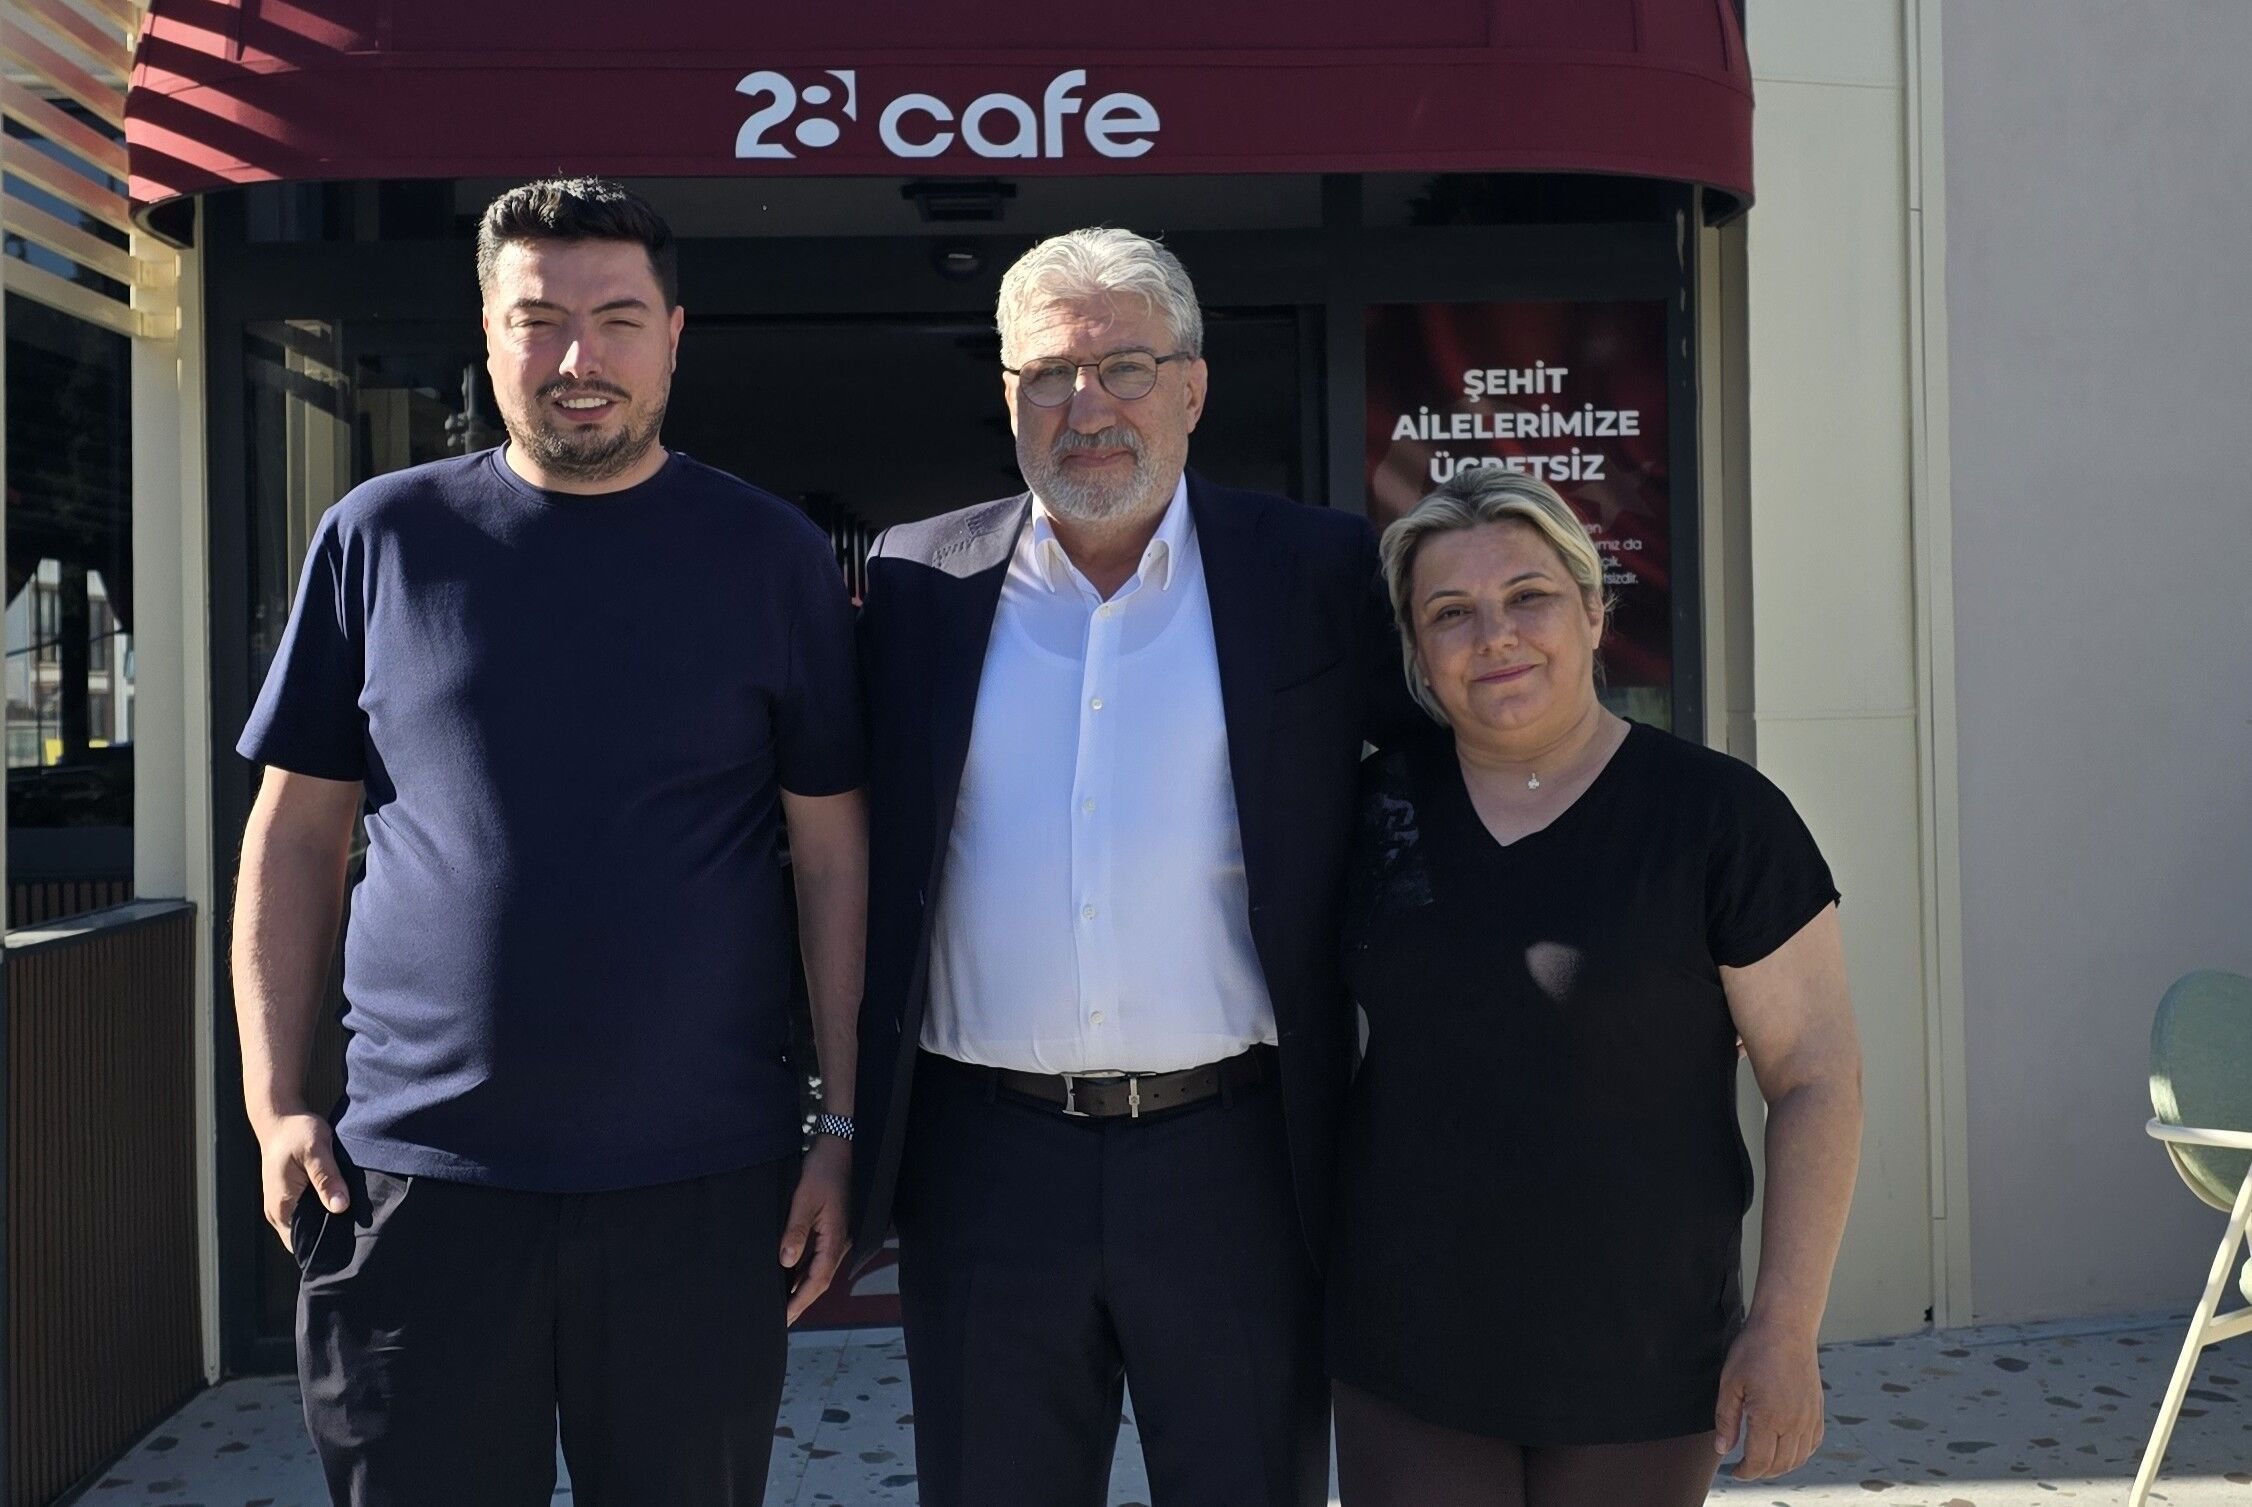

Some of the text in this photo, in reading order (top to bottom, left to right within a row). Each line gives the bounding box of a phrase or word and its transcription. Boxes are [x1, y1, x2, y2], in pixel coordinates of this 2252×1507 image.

[879, 69, 1160, 158] cafe
[1463, 360, 1568, 402] ŞEHİT
[1391, 403, 1641, 441] AİLELERİMİZE
